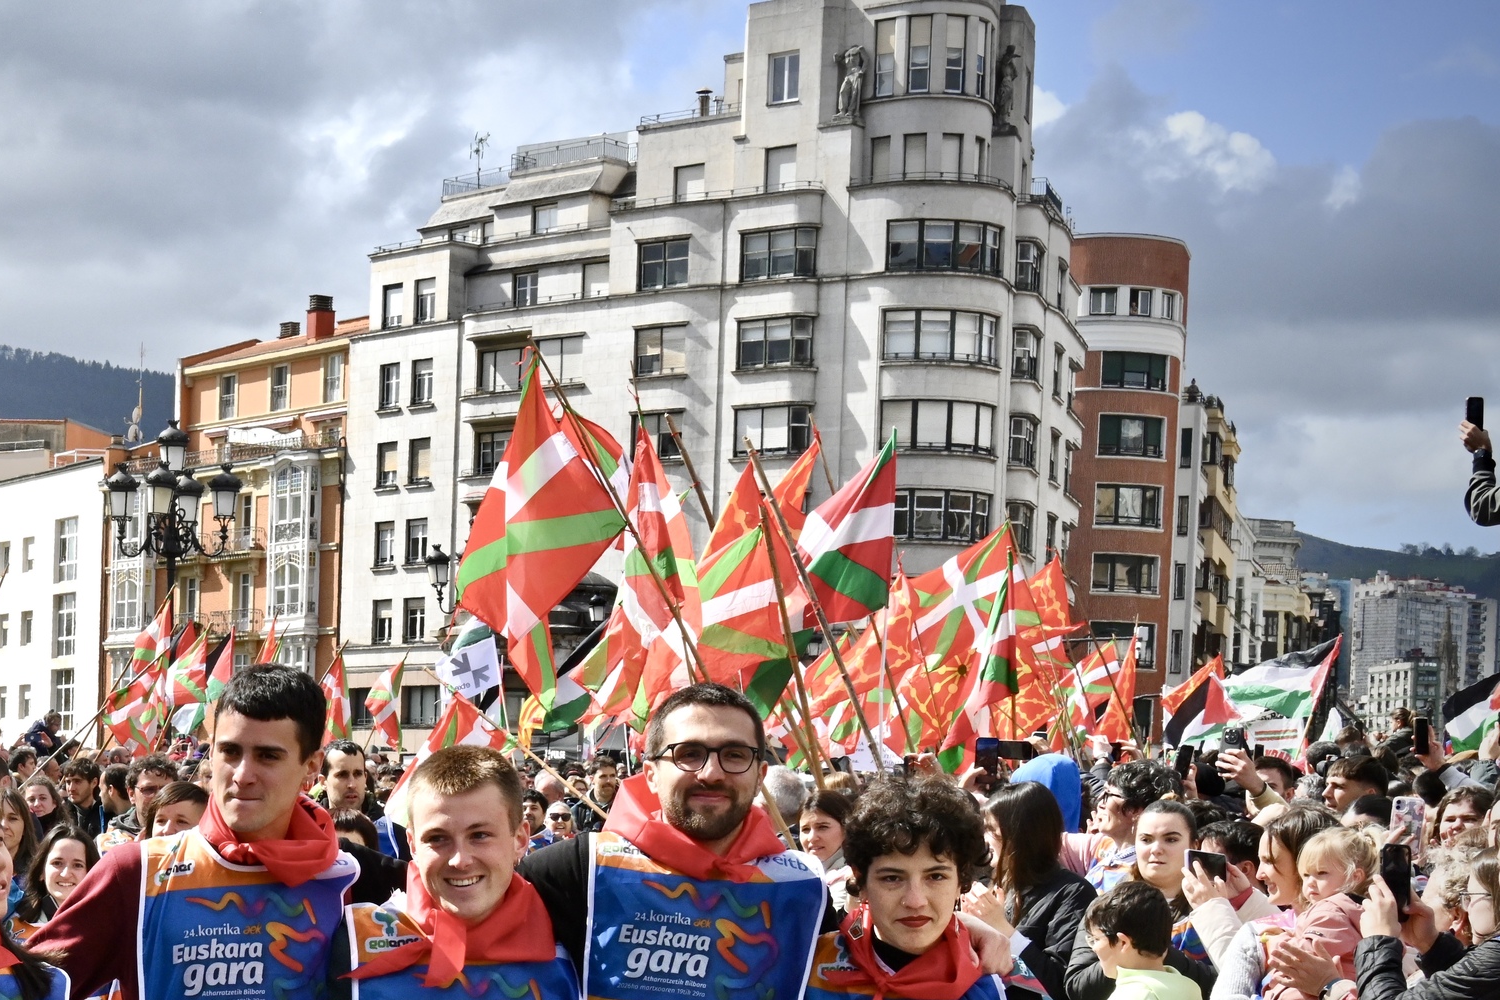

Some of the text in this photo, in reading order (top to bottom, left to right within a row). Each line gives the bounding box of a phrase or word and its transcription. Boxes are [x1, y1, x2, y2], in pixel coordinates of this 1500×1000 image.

[634, 910, 691, 926] 24.korrika
[184, 924, 241, 939] 24.korrika
[618, 924, 711, 952] Euskara
[172, 938, 263, 965] Euskara
[626, 948, 710, 978] gara
[183, 960, 264, 997] gara
[642, 975, 707, 989] Atharratzetik Bilbora
[202, 988, 266, 997] Atharratzetik Bilbora
